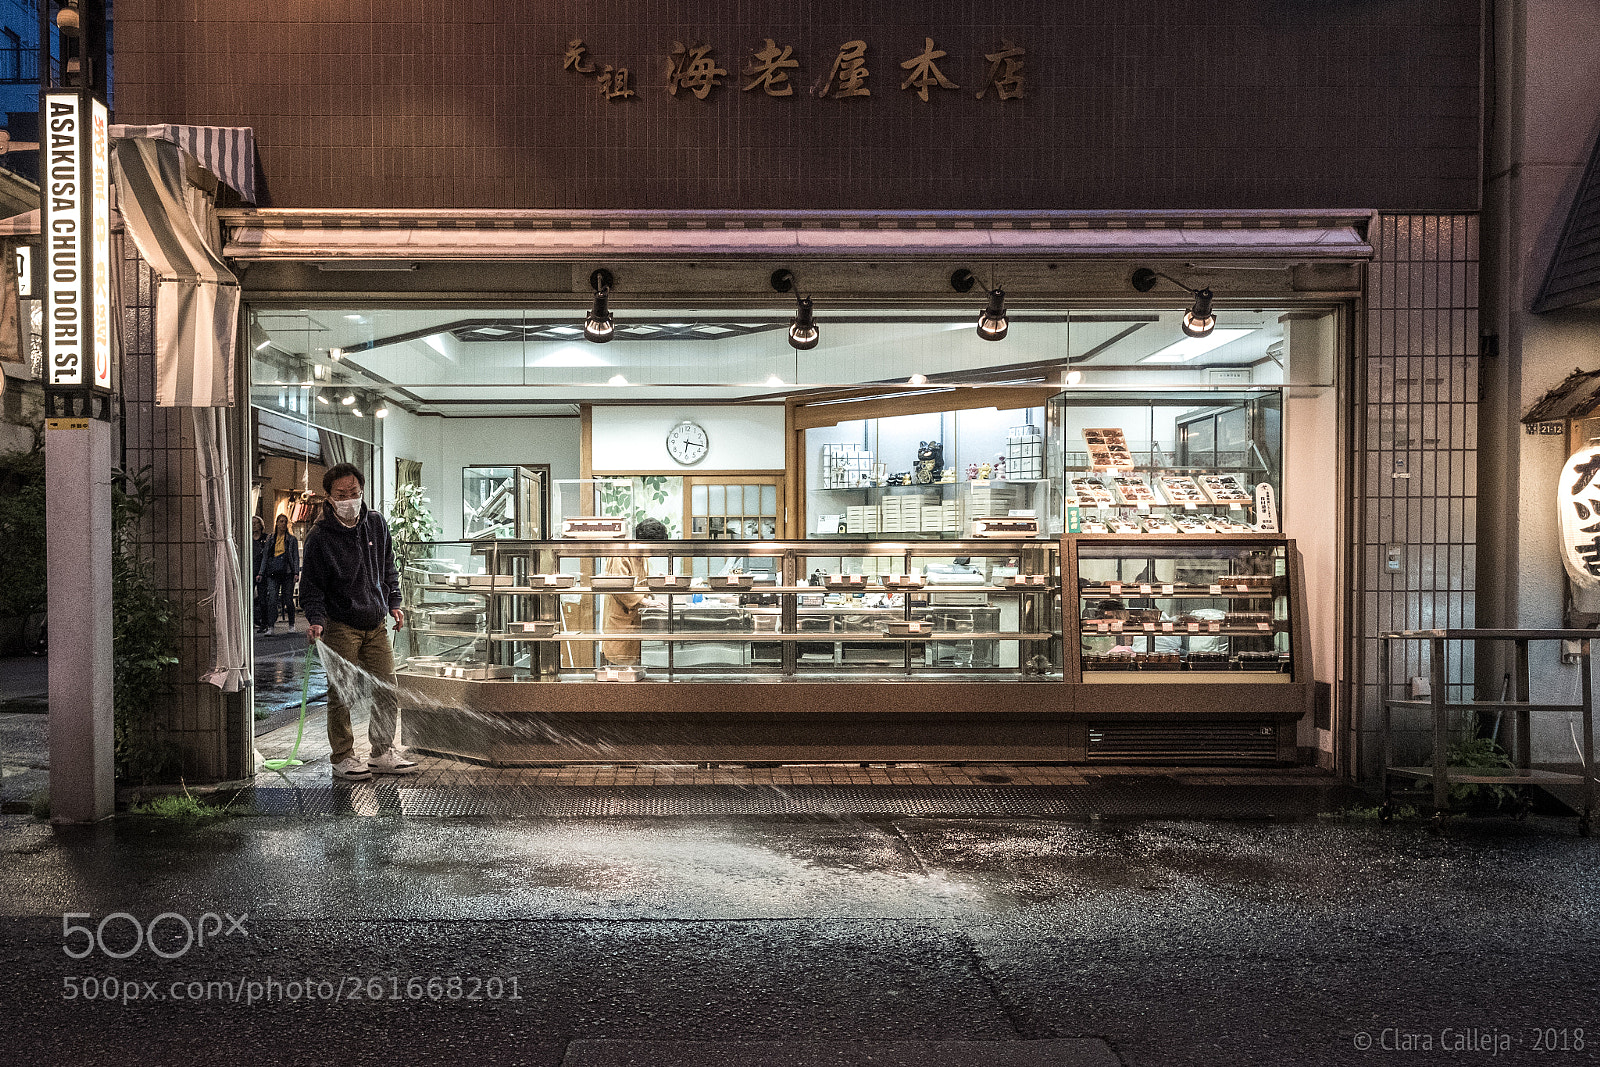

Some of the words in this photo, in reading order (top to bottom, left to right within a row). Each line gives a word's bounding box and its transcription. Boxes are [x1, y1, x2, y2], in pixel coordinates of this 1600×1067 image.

[563, 38, 636, 101] 元祖
[666, 37, 1027, 102] 海老屋本店
[50, 102, 75, 213] ASAKUSA
[52, 219, 77, 283] CHUO
[53, 290, 78, 346] DORI
[54, 353, 79, 384] St.
[1541, 426, 1562, 434] 21-12
